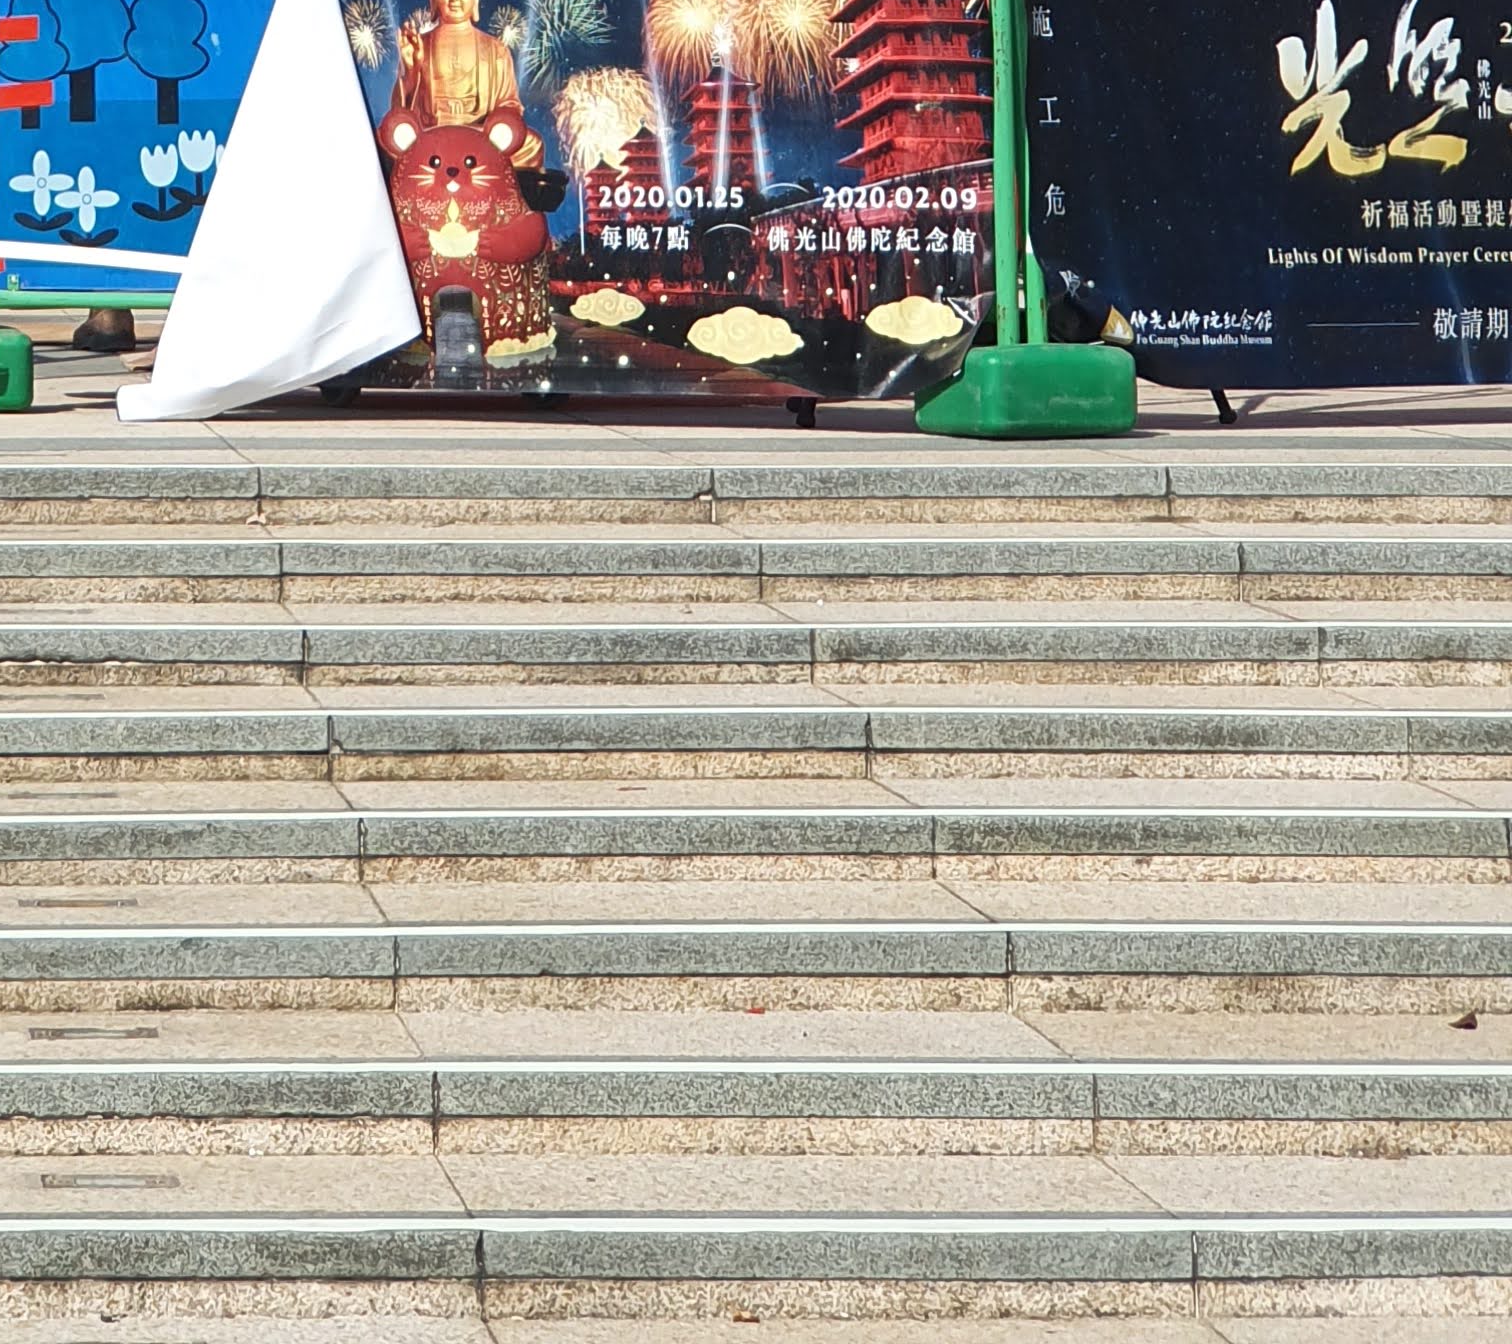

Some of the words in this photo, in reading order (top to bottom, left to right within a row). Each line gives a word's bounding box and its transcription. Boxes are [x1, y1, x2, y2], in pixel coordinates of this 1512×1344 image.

[1476, 59, 1493, 120] 佛光山
[598, 185, 744, 210] 2020.01.25
[821, 185, 979, 211] 2020.02.09
[1359, 198, 1512, 228] 祈福活動暨提
[600, 224, 690, 252] 每晚7點
[766, 225, 978, 254] 佛光山佛陀紀念館
[1267, 247, 1319, 269] Lights
[1322, 247, 1344, 264] Of
[1346, 246, 1413, 264] Wisdom
[1418, 246, 1468, 268] Prayer
[1472, 246, 1512, 263] Cere
[1149, 334, 1179, 347] Guang
[1180, 334, 1200, 345] Shan
[1202, 333, 1238, 345] Buddha
[1239, 334, 1273, 345] Museum
